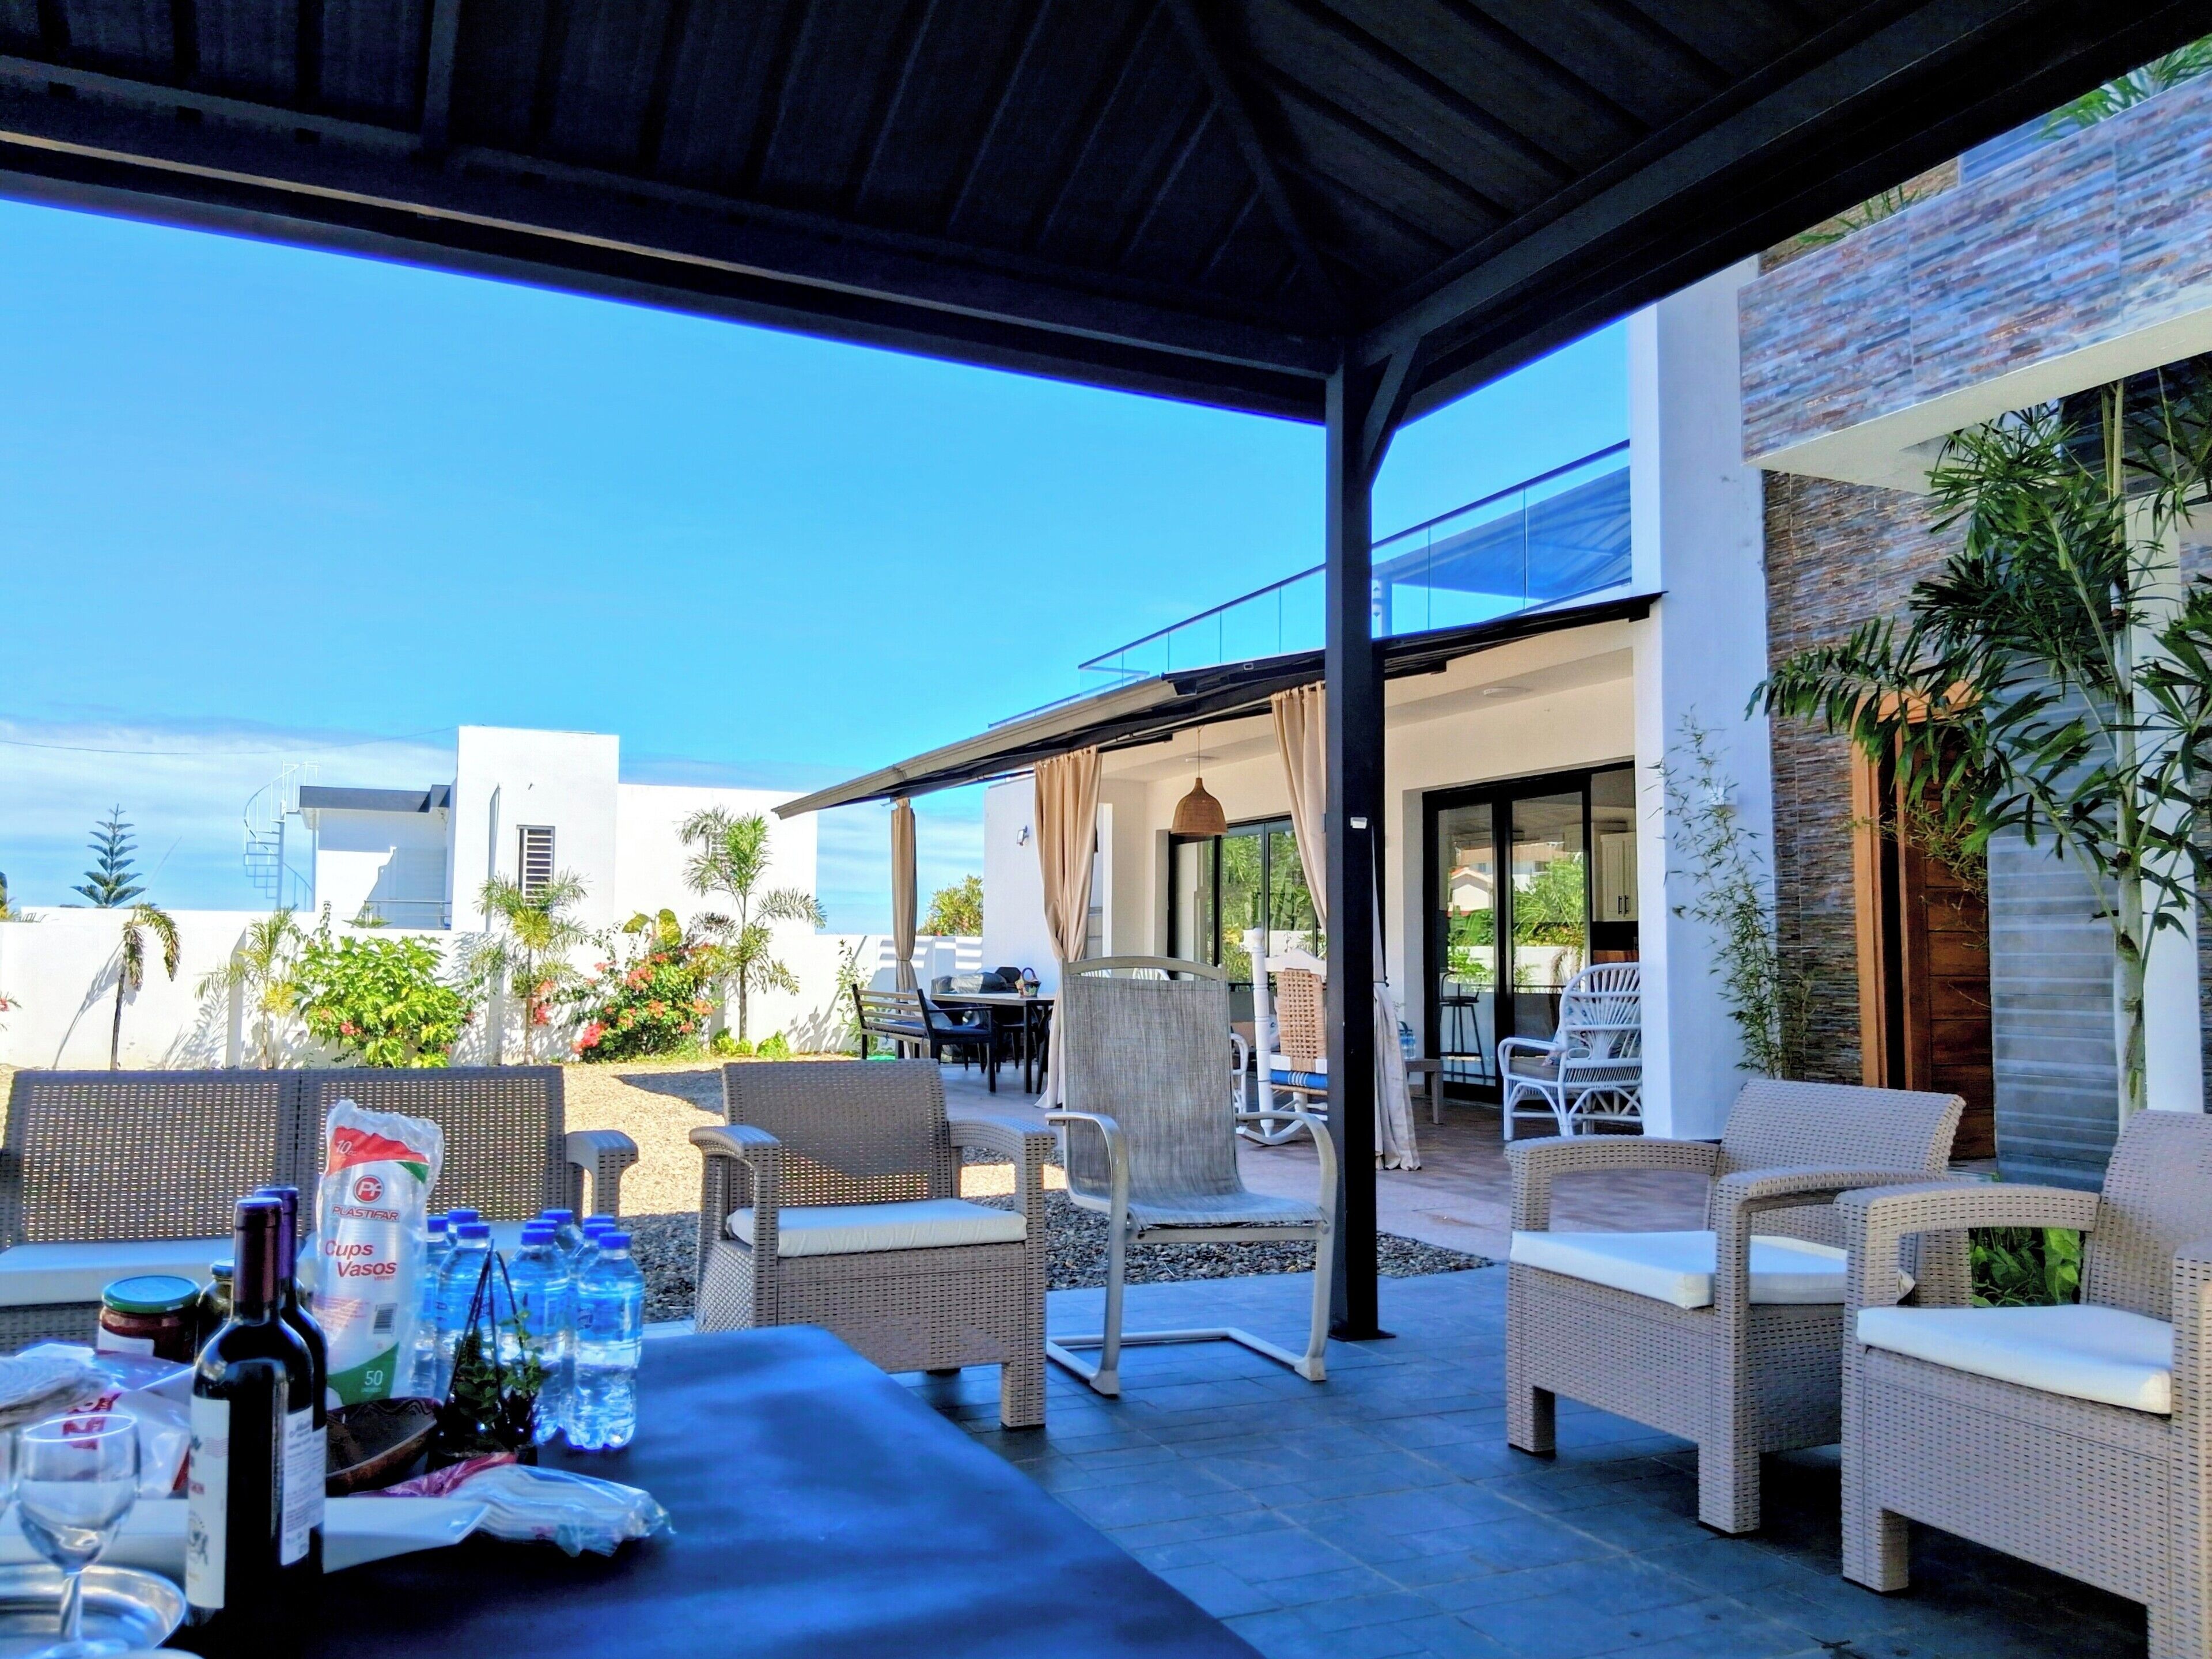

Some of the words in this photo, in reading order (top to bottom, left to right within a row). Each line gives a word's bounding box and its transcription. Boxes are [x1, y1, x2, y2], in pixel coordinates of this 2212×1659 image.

[332, 1206, 399, 1221] PLASTIFAR
[325, 1240, 374, 1260] Cups
[338, 1261, 397, 1277] Vasos
[365, 1370, 384, 1386] 50
